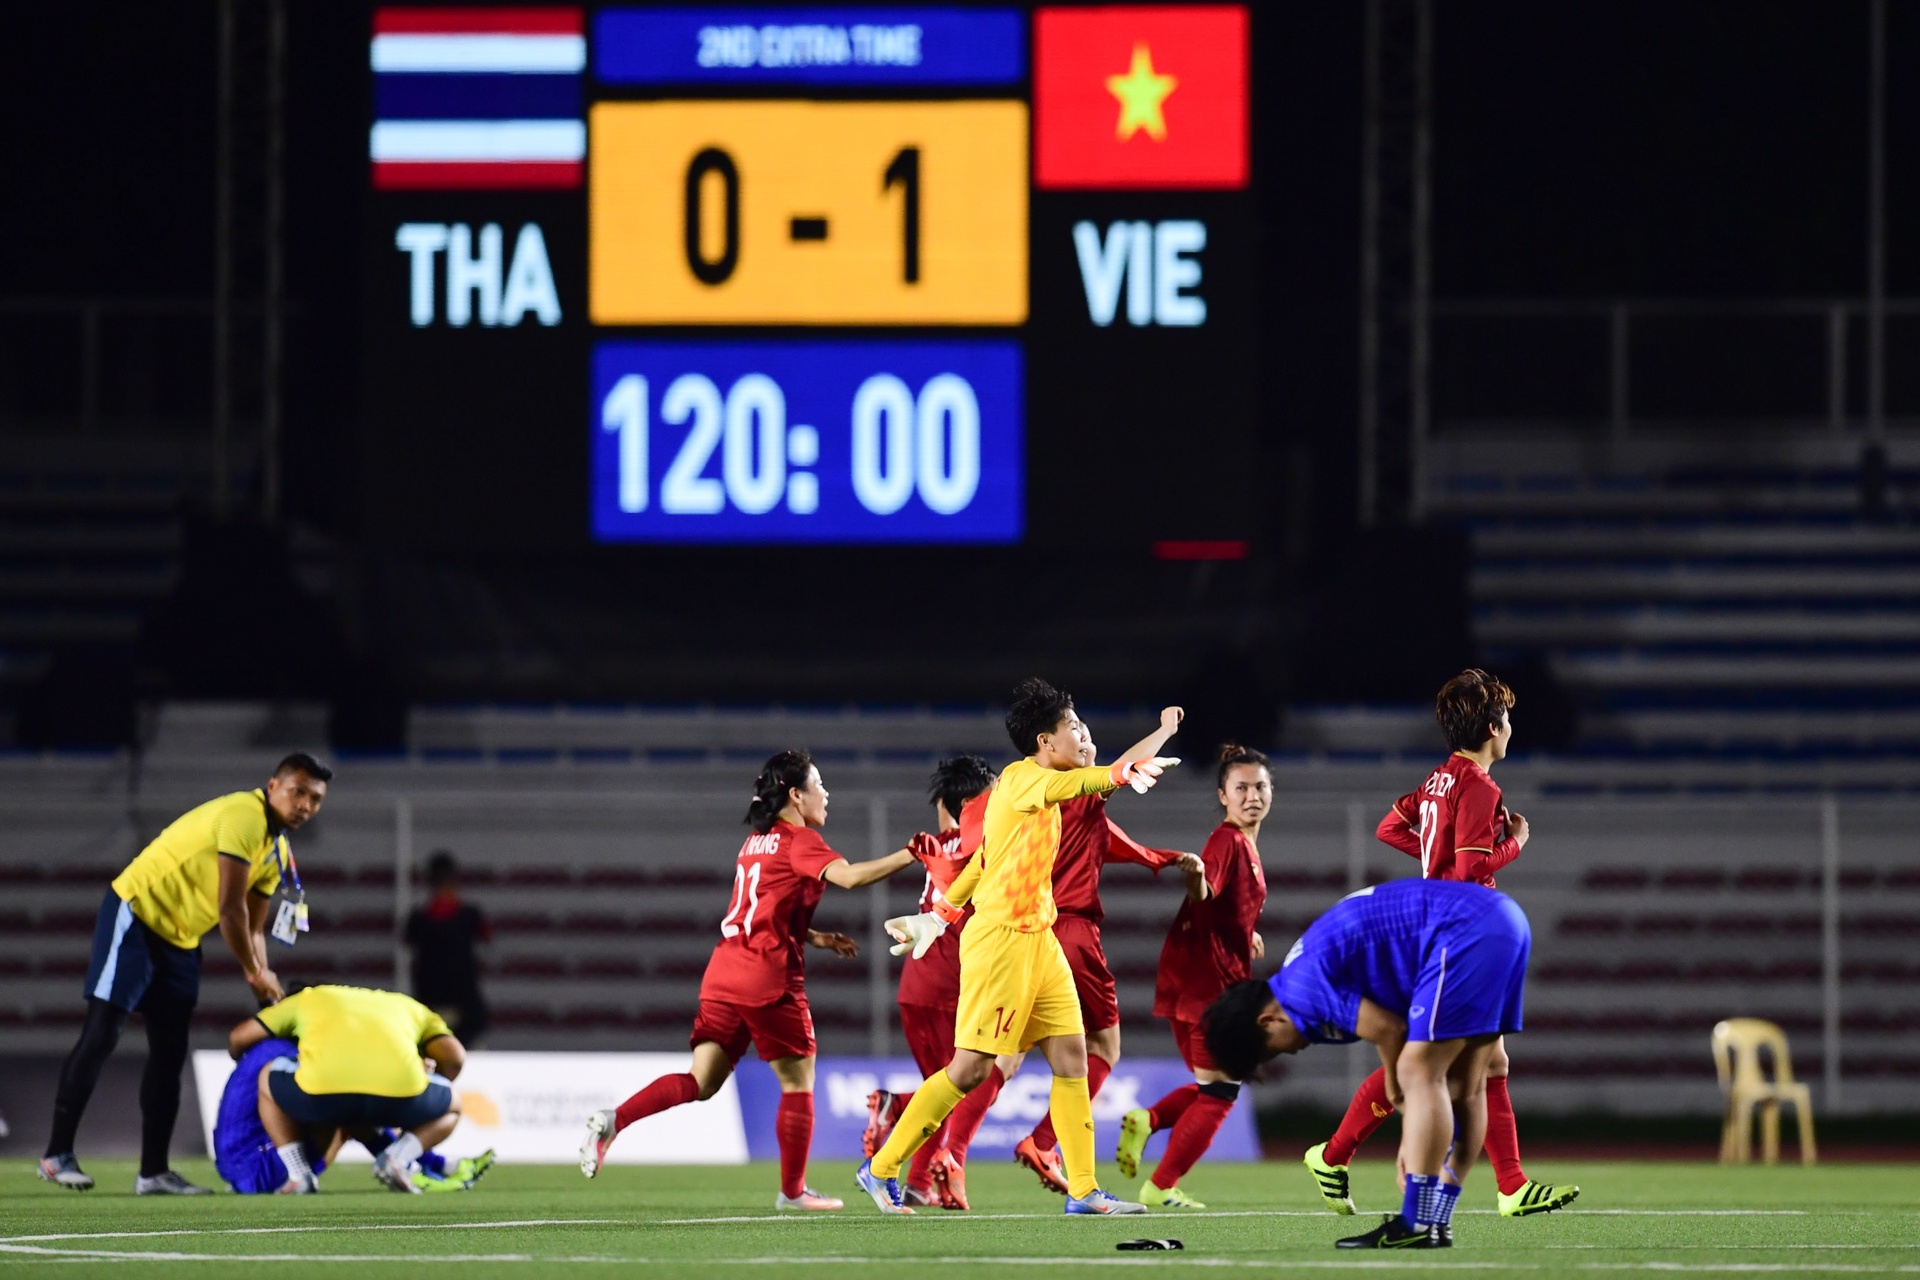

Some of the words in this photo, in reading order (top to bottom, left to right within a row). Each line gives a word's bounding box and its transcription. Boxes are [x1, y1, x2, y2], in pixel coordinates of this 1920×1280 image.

[758, 25, 850, 67] EXTRA
[851, 25, 921, 66] TIME
[684, 146, 740, 287] 0
[882, 146, 920, 286] 1
[395, 223, 562, 327] THA
[1074, 221, 1207, 327] VIE
[720, 862, 761, 939] 21
[994, 1006, 1016, 1040] 14
